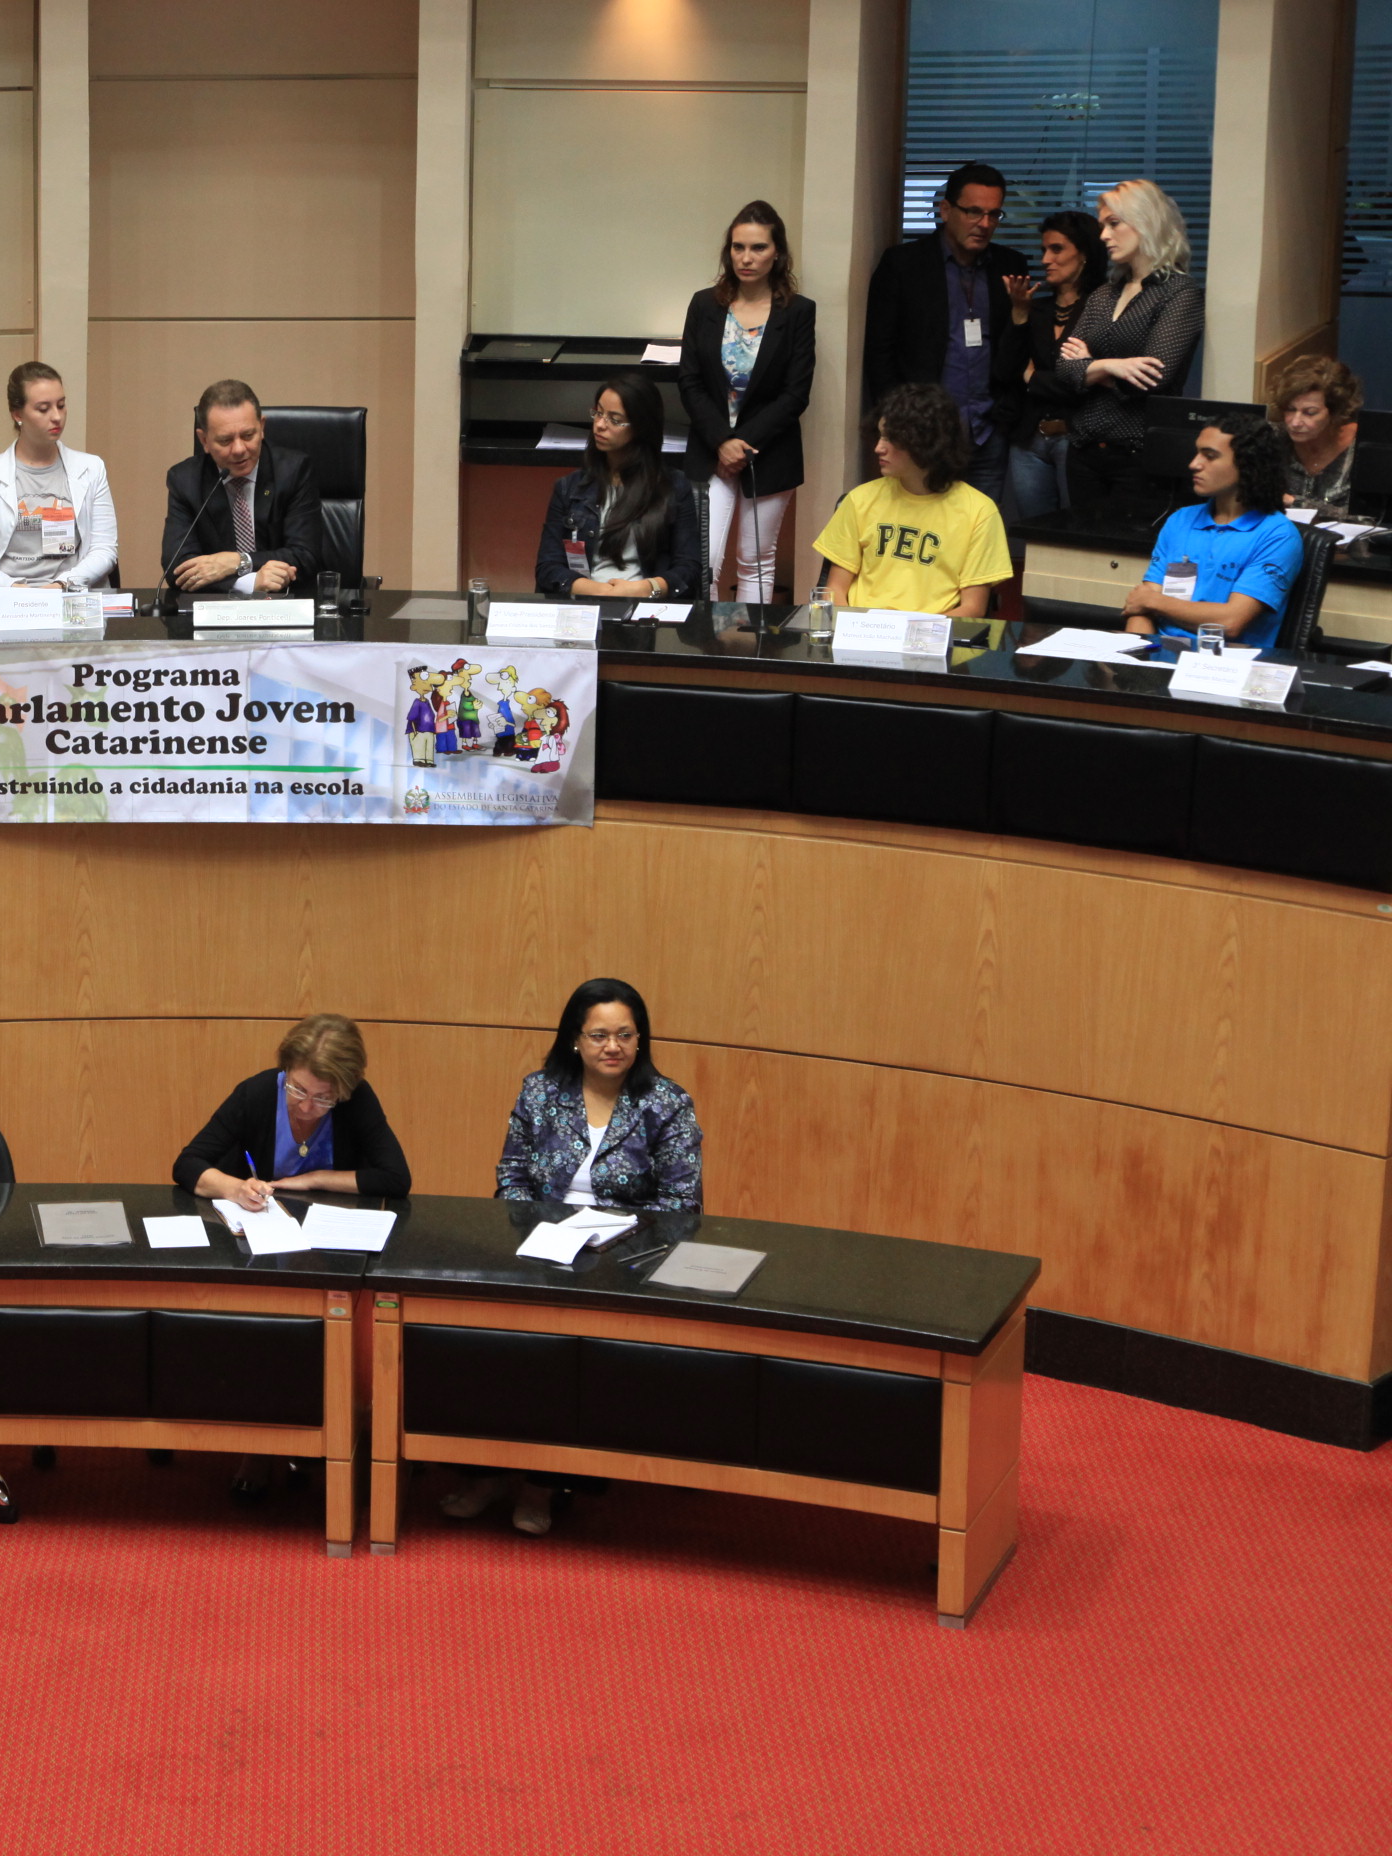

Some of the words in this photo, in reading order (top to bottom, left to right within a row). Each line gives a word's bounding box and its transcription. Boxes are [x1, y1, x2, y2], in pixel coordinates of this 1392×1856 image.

[875, 523, 941, 566] PEC
[860, 621, 896, 630] Secretário
[72, 664, 240, 692] Programa
[215, 693, 356, 724] Jovem
[45, 728, 268, 755] Catarinense
[110, 782, 123, 795] a
[129, 777, 248, 795] cidadania
[254, 782, 284, 795] na
[290, 778, 365, 796] escola
[434, 791, 494, 802] ASSEMBLEIA
[496, 793, 559, 804] LEGISLATIVA
[493, 804, 518, 812] SANTA
[519, 805, 559, 813] CATARINA
